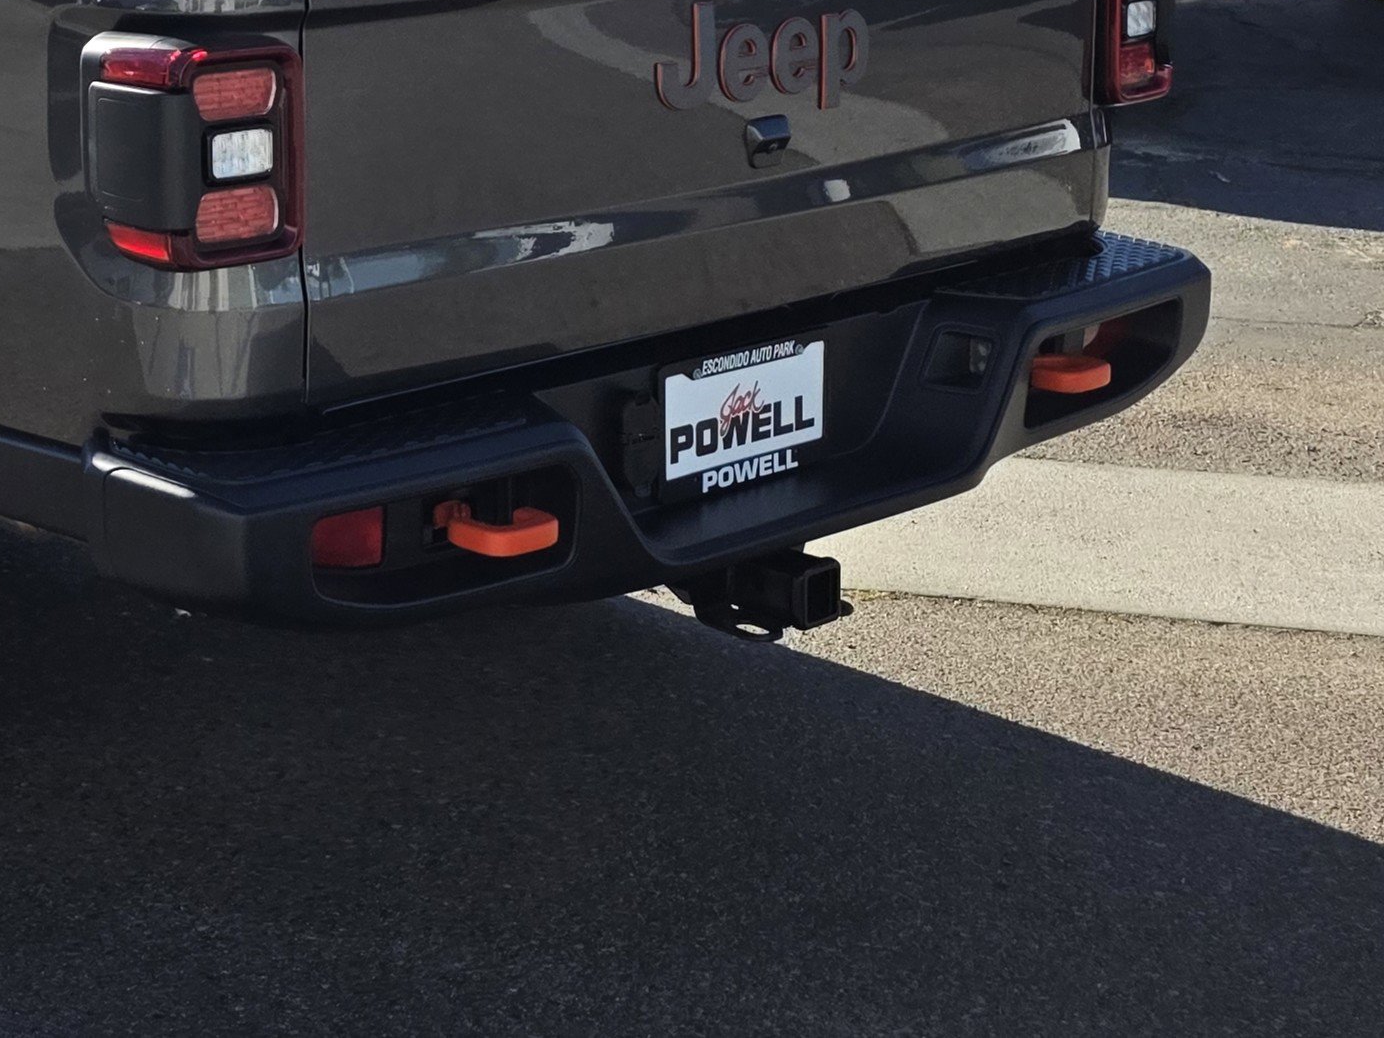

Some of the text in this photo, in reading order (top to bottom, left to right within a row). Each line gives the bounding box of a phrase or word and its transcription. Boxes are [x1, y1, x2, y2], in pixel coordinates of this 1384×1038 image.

[654, 1, 869, 111] Jeep
[702, 340, 795, 376] ESCONDIDO AUTO PARK
[670, 395, 815, 465] POWELL
[720, 380, 765, 437] Jack
[702, 449, 799, 493] POWELL
